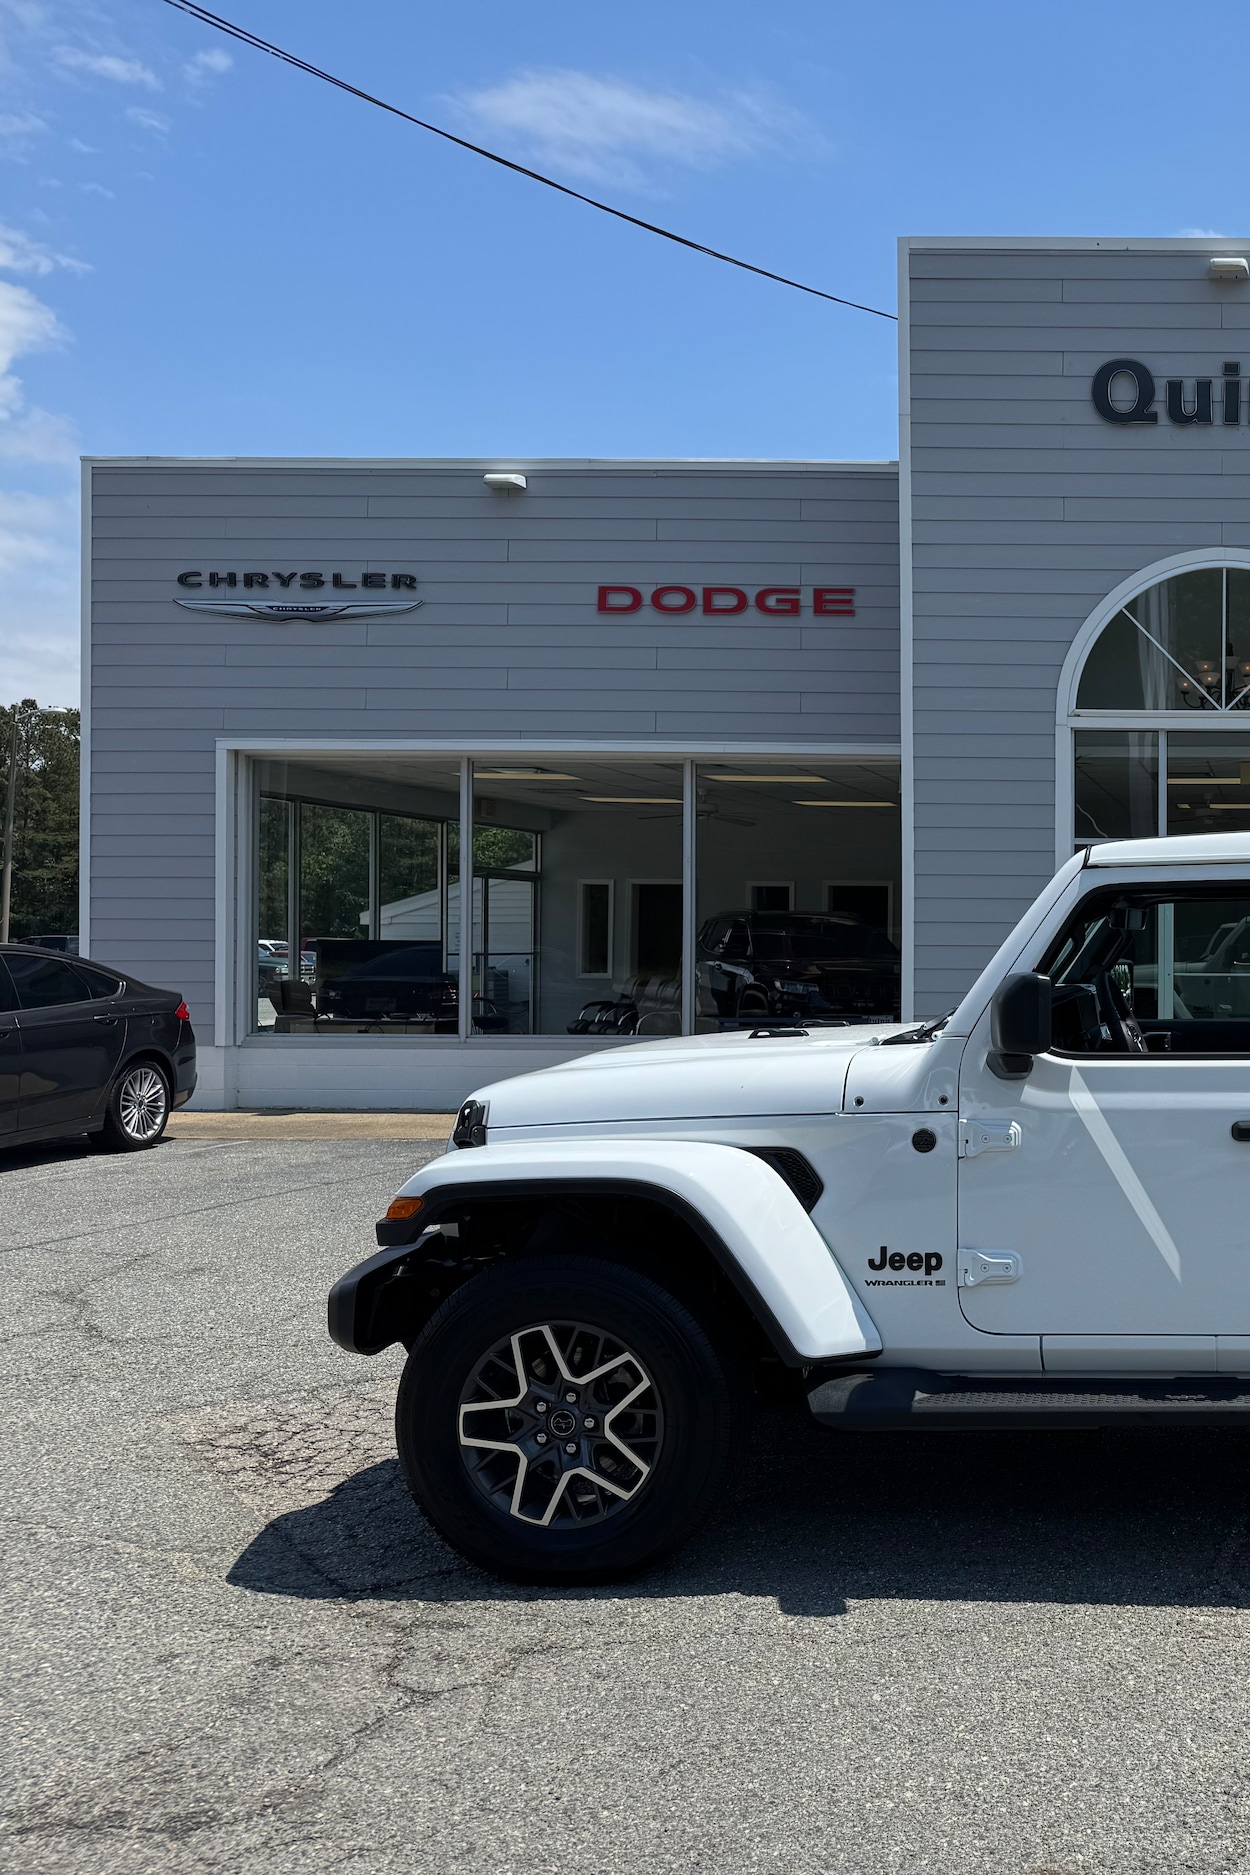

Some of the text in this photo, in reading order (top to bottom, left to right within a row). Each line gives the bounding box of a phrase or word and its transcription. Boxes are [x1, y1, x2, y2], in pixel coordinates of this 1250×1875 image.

[176, 570, 417, 590] CHRYSLER
[597, 585, 856, 617] DODGE
[867, 1245, 943, 1276] Jeep
